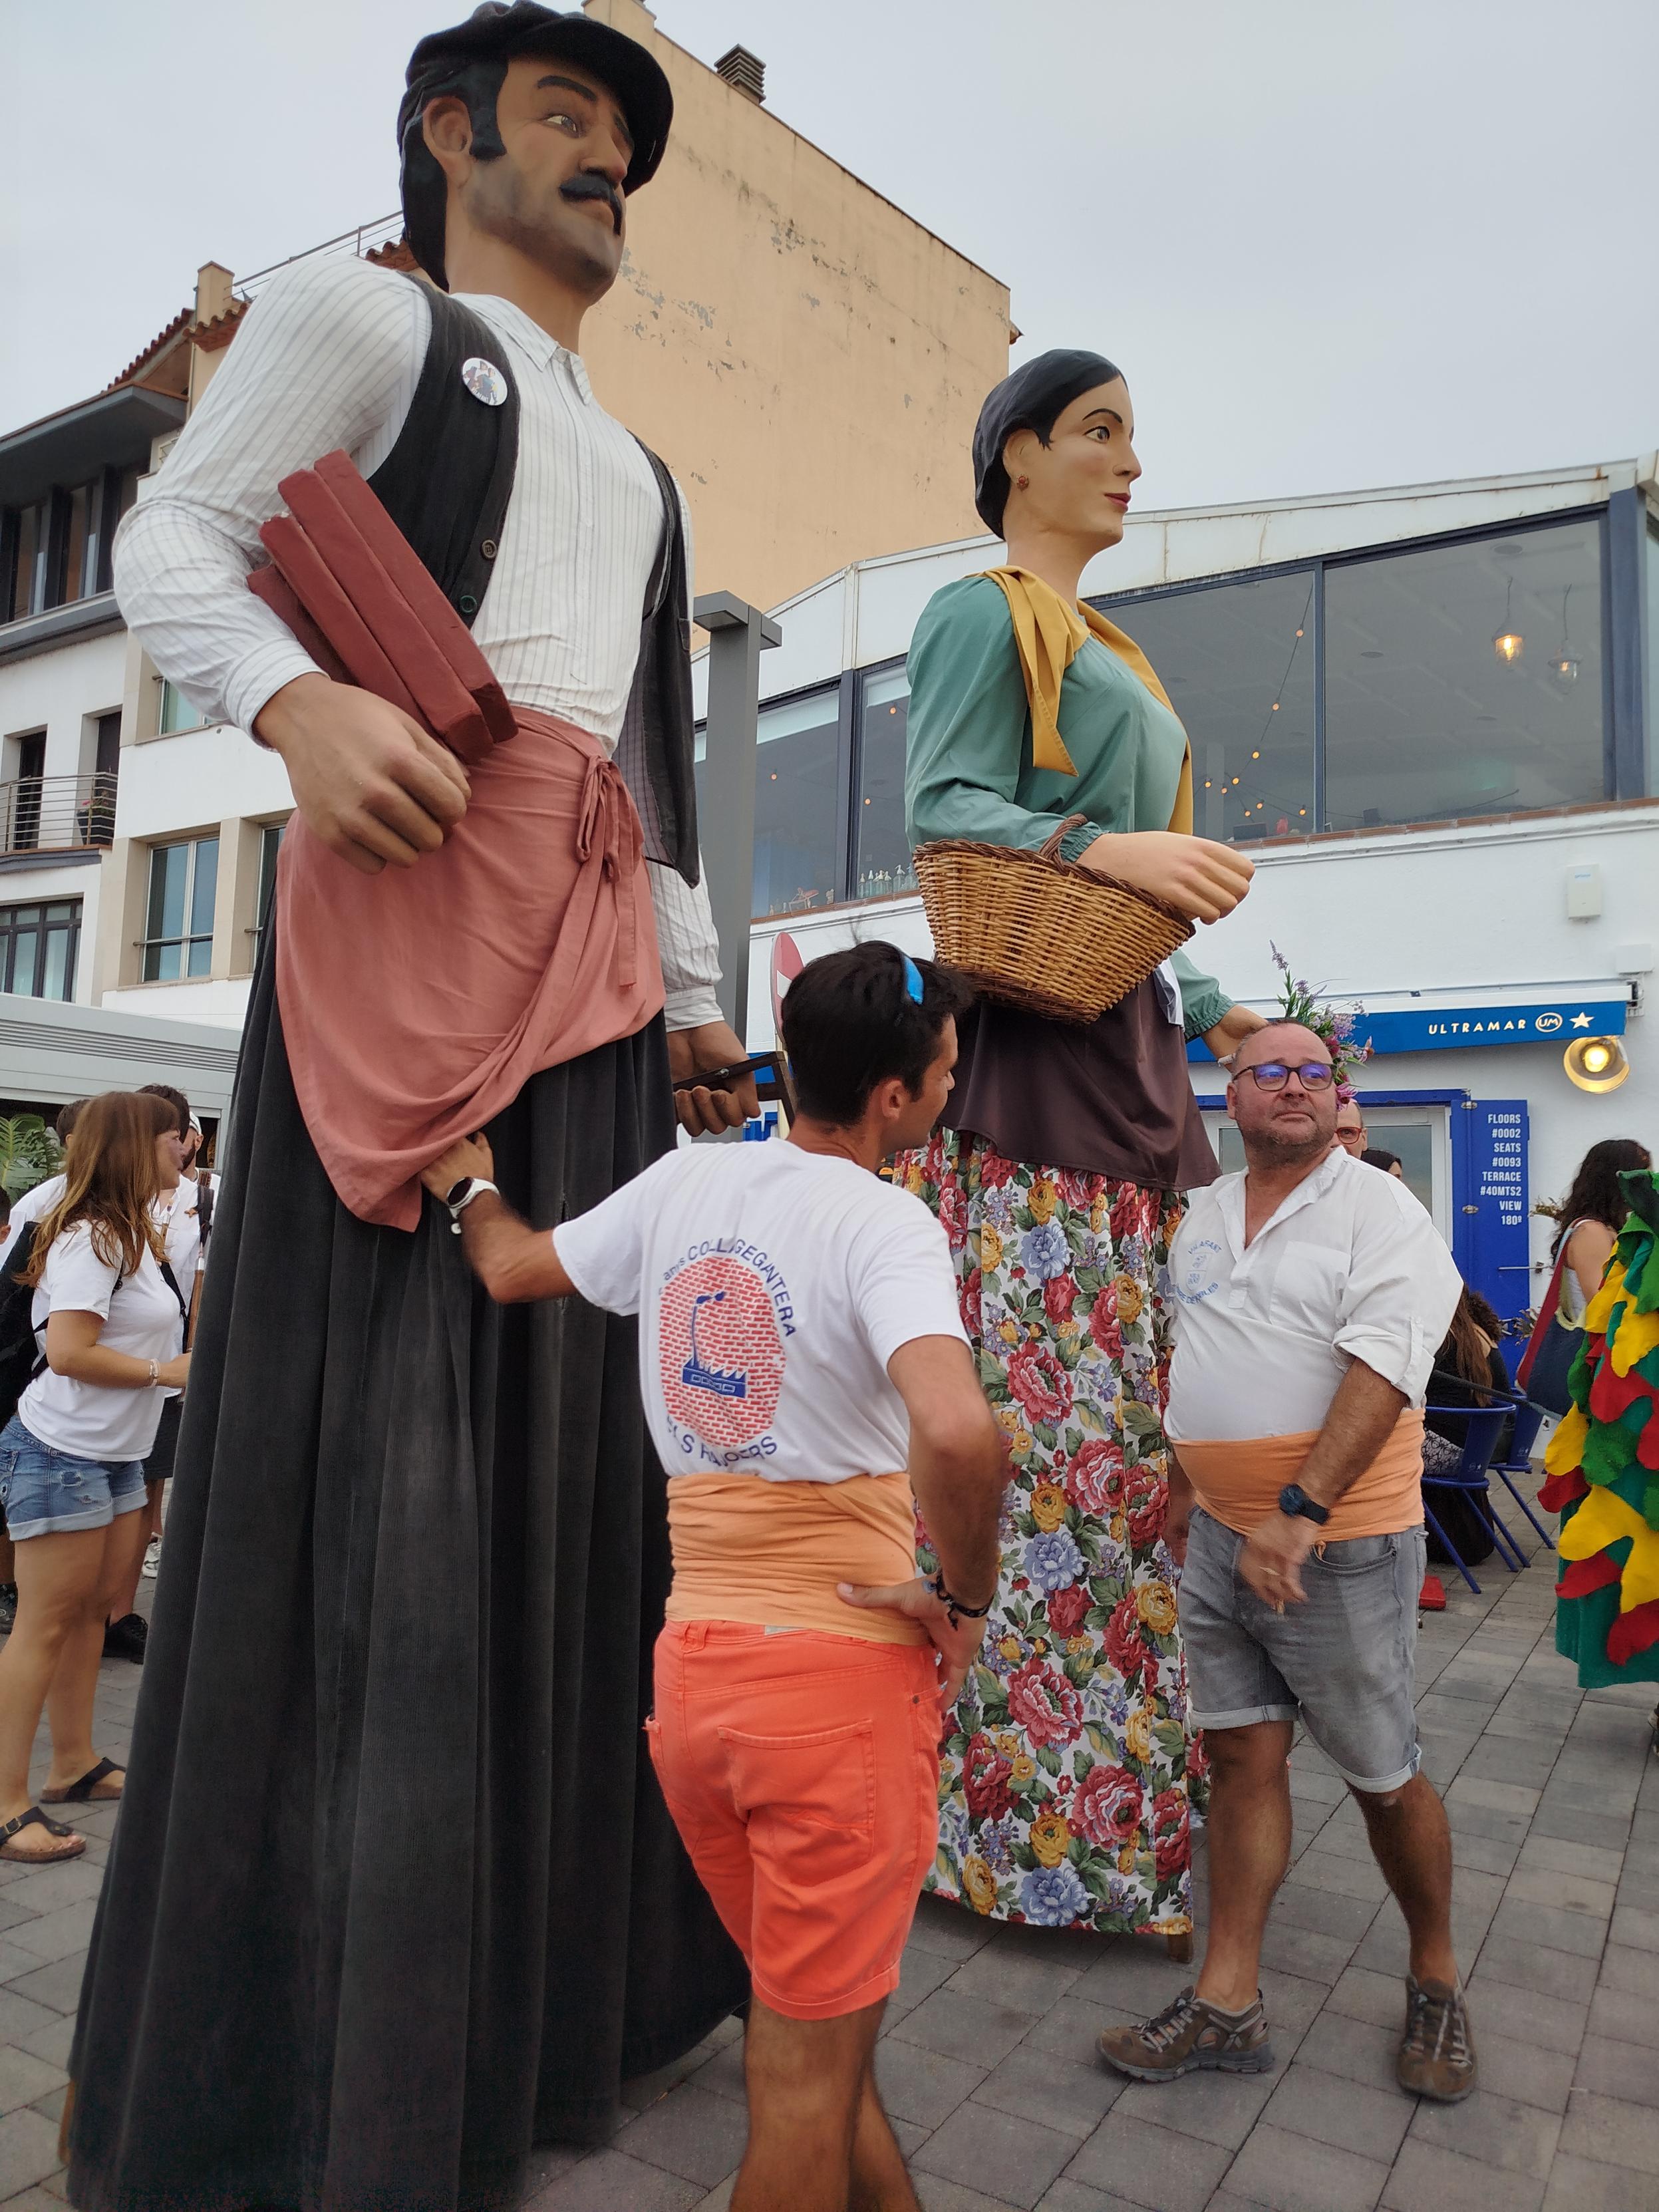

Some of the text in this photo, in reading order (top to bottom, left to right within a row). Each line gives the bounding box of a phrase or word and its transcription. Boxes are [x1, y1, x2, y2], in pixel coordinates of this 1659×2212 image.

[1428, 1019, 1527, 1035] ULTRAMAR
[1487, 1114, 1521, 1124] FLOORS
[1492, 1128, 1521, 1138] #0002
[1493, 1143, 1522, 1153] SEATS
[1492, 1157, 1522, 1168] #0093
[1481, 1172, 1522, 1182] TERRACE
[1480, 1186, 1522, 1196] #40MTS2
[1499, 1200, 1522, 1211] VIEW
